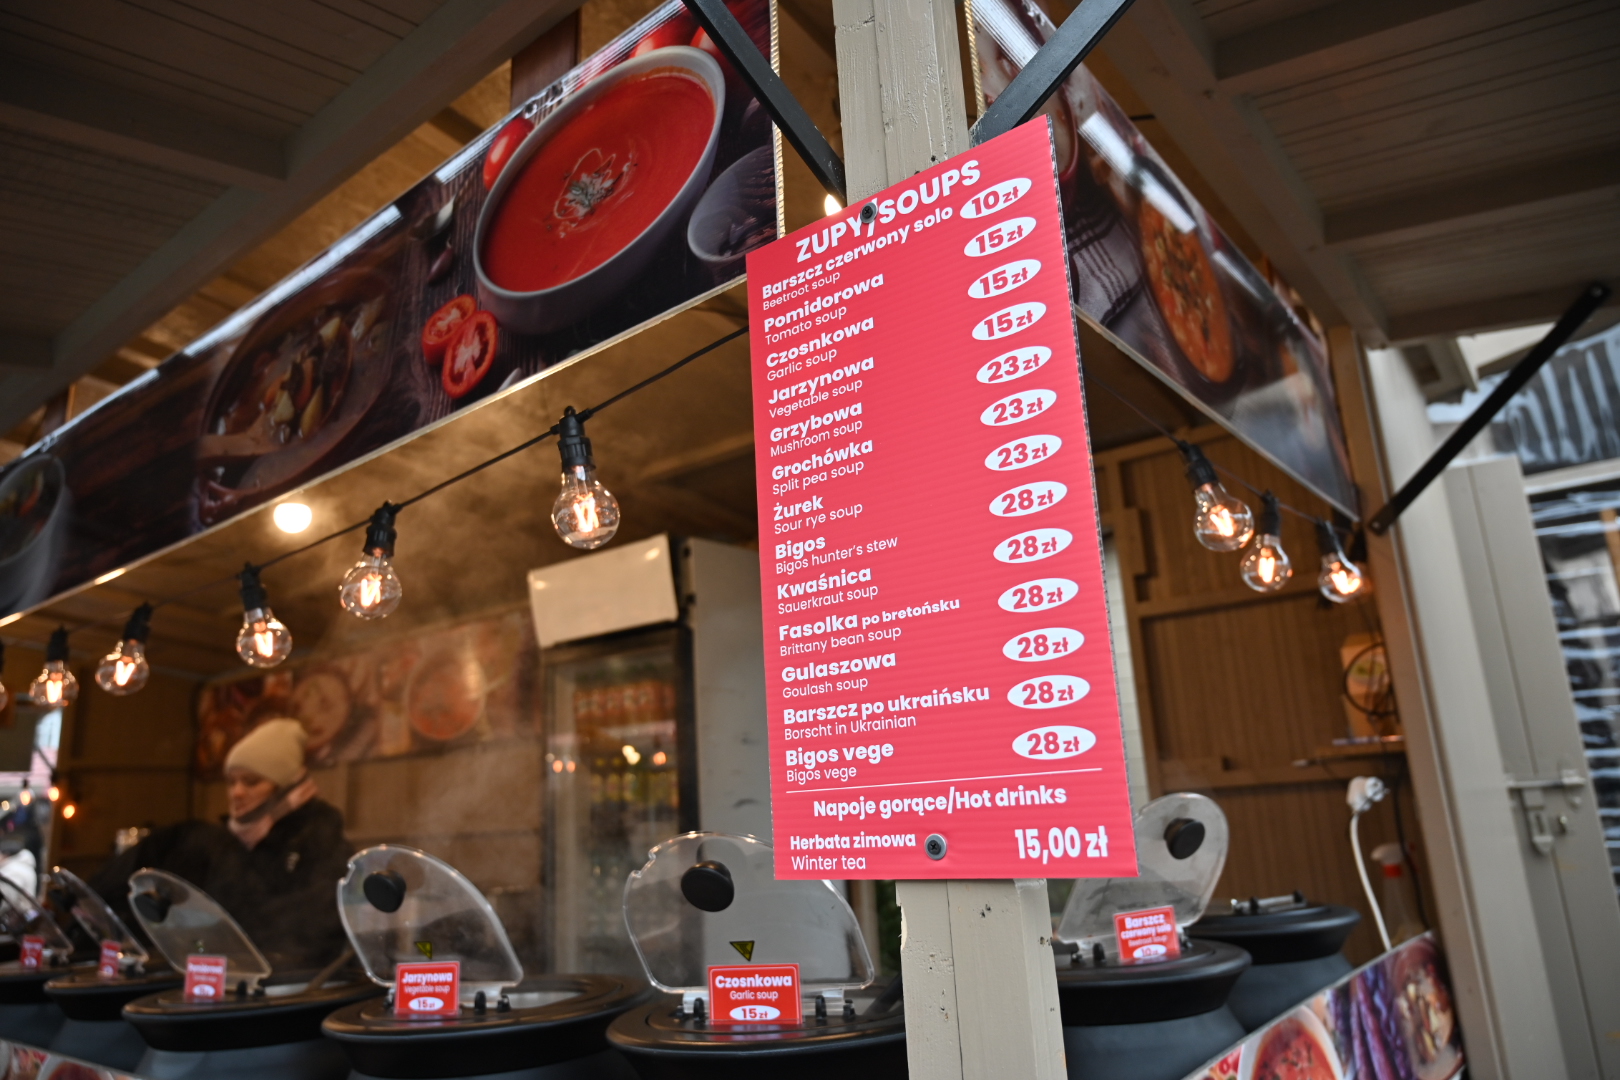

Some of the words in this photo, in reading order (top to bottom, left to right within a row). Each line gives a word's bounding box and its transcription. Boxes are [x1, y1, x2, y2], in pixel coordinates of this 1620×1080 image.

[762, 264, 823, 299] Barszcz
[825, 223, 911, 271] czerwony
[914, 206, 953, 233] solo
[763, 284, 810, 311] Beetroot
[811, 272, 841, 290] soup
[764, 273, 884, 332] Pomidorowa
[765, 319, 812, 345] Tomato
[814, 306, 847, 326] soup
[766, 316, 874, 368] Czosnkowa
[767, 361, 803, 381] Garlic
[805, 348, 838, 368] soup
[768, 356, 875, 405] Jarzynowa
[769, 388, 829, 418] Vegetable
[832, 379, 863, 398] soup
[769, 402, 863, 442] Grzybowa
[770, 430, 831, 457] Mushroom
[833, 420, 863, 437] soup
[771, 439, 874, 480] Grochówka
[772, 477, 800, 496] Split
[802, 471, 828, 490] pea
[831, 461, 865, 478] soup
[773, 495, 824, 521] Żurek
[774, 519, 803, 535] Sour
[805, 514, 827, 529] rye
[829, 503, 863, 521] soup
[775, 536, 826, 560] Bigos
[776, 558, 809, 575] Bigos
[866, 537, 899, 552] stew
[777, 567, 872, 600] Kwaśnica
[778, 591, 844, 615] Sauerkraut
[846, 584, 879, 601] soup
[778, 614, 858, 641] Fasolka
[861, 613, 880, 630] po
[881, 598, 961, 623] bretońsku
[779, 640, 828, 657] Brittany
[830, 633, 865, 648] bean
[867, 627, 902, 642] soup
[781, 652, 897, 683] Gulaszowa
[782, 680, 833, 699] Goulash
[837, 677, 869, 692] soup
[783, 703, 858, 724] Barszcz
[861, 701, 885, 721] po
[887, 686, 990, 712] ukraińsku
[784, 722, 833, 740] Borscht
[835, 722, 847, 736] in
[850, 714, 917, 734] Ukrainian
[785, 746, 839, 770] Bigos
[842, 743, 894, 765] vege
[786, 769, 822, 786] Bigos
[823, 766, 857, 782] vege
[813, 797, 877, 821] Napoje
[879, 786, 992, 820] gorące/Hot
[995, 785, 1067, 808] drinks
[790, 834, 851, 851] Herbata
[852, 830, 917, 849] zimowa
[1014, 826, 1081, 865] 15,00
[1085, 825, 1109, 859] zł
[791, 854, 839, 871] Winter
[841, 855, 867, 870] tea
[1125, 914, 1165, 929] Barszcz
[402, 972, 453, 985] Jarzynowa
[715, 974, 792, 988] Czosnkowa
[730, 990, 755, 1000] Garlic
[757, 991, 778, 1002] soup
